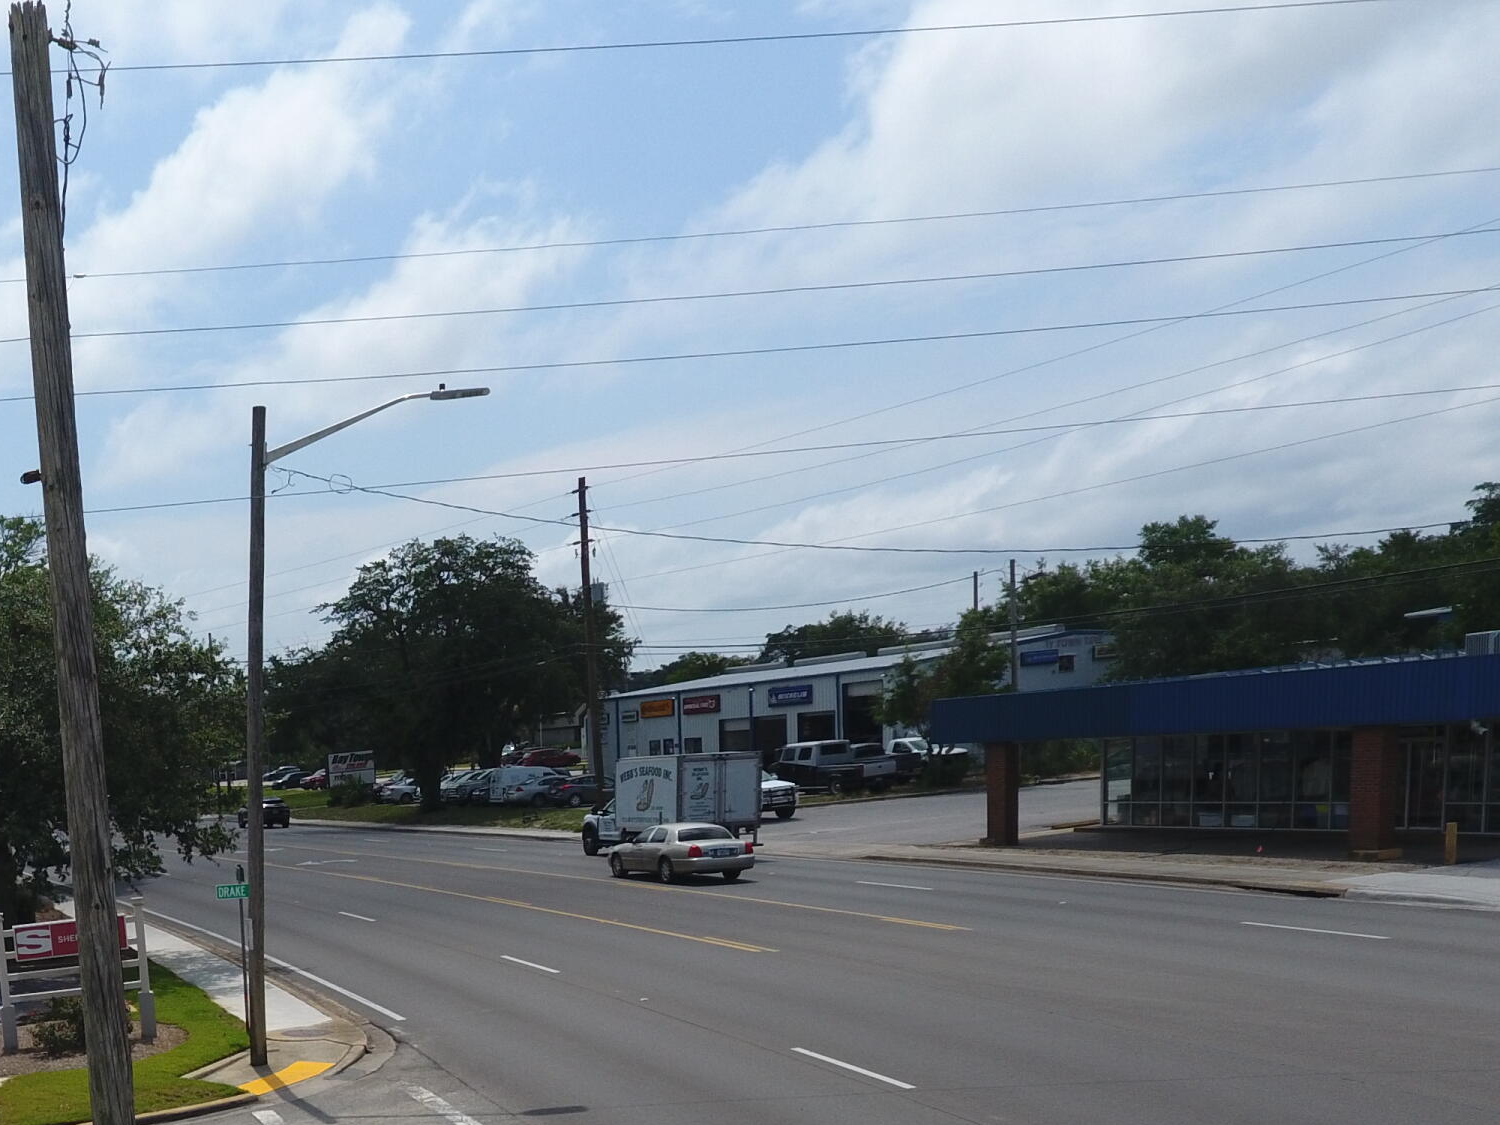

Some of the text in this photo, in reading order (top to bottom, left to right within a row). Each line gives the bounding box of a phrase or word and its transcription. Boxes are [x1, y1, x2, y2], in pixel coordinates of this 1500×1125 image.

[620, 767, 638, 784] WEBB'S
[639, 765, 662, 778] SEAFOOD
[217, 885, 247, 898] DRAKE
[16, 929, 53, 955] S
